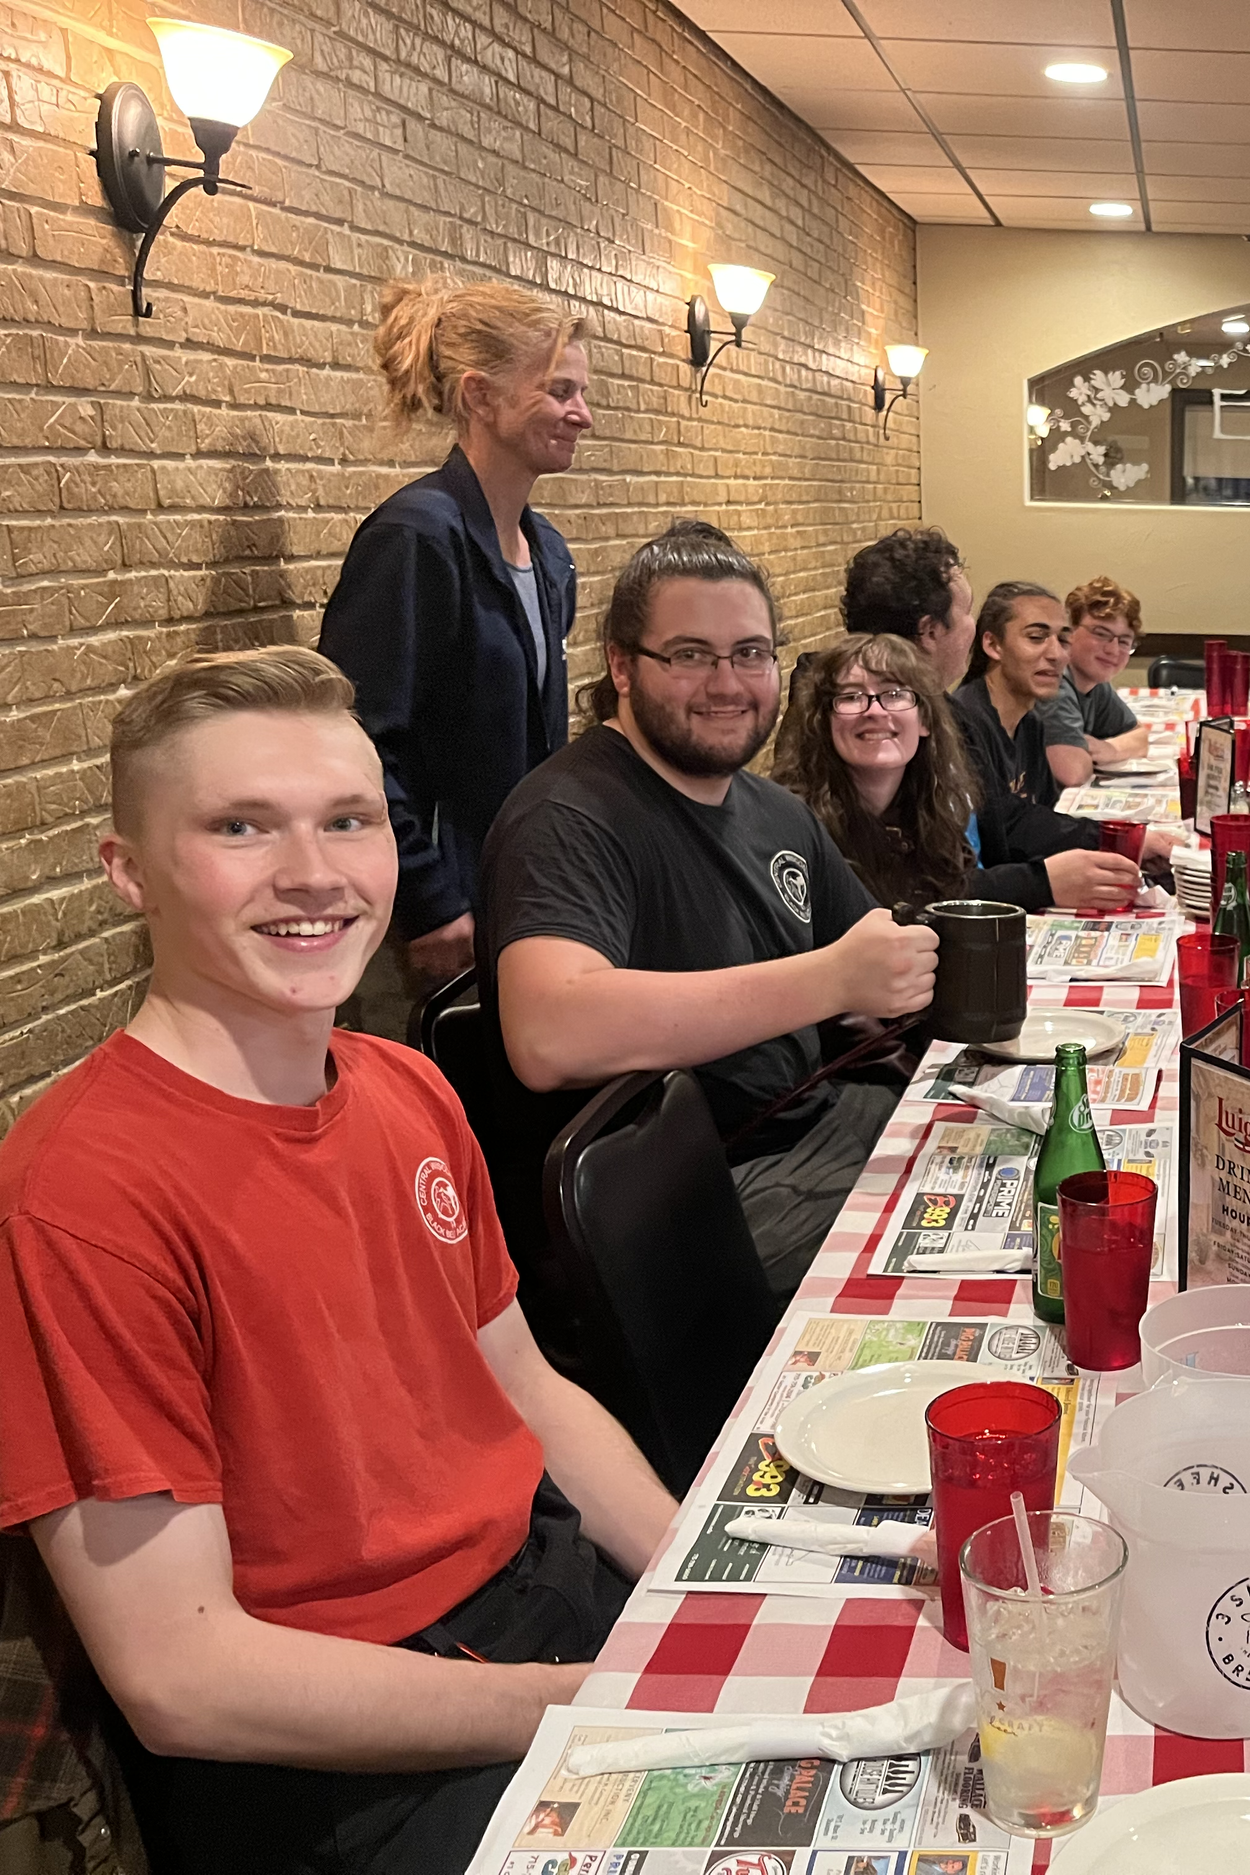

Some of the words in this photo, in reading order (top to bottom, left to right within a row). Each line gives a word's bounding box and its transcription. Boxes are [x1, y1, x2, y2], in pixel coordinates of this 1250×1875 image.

[418, 1166, 432, 1206] CENTRAL
[992, 1179, 1019, 1218] PRIME
[426, 1212, 445, 1236] BLACK
[1215, 1612, 1232, 1626] 3
[999, 1718, 1045, 1733] CRAFT
[783, 1768, 817, 1814] PALACE
[958, 1766, 975, 1810] FLOORING
[970, 1768, 985, 1810] WALLACE
